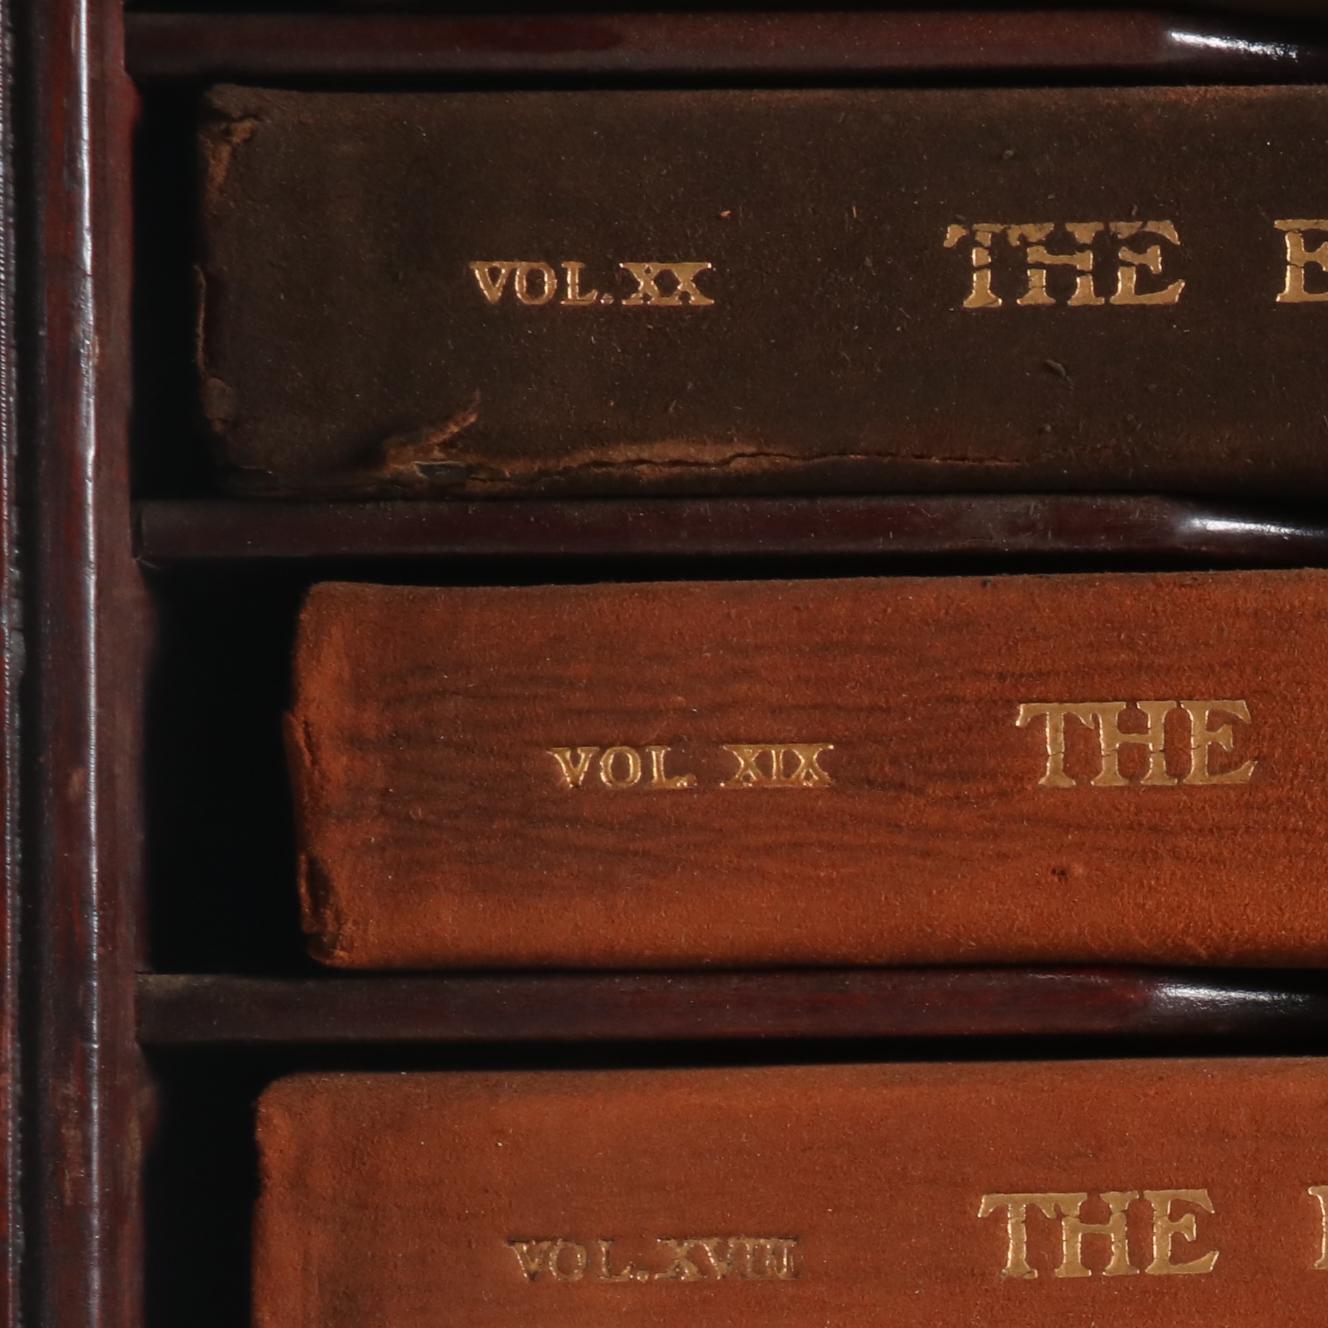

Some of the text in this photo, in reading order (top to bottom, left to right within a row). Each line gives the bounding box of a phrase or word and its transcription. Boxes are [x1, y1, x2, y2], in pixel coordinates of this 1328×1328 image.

[943, 219, 1187, 310] THE
[720, 742, 835, 790] XIX
[1014, 697, 1256, 790] THE
[976, 1188, 1221, 1279] THE
